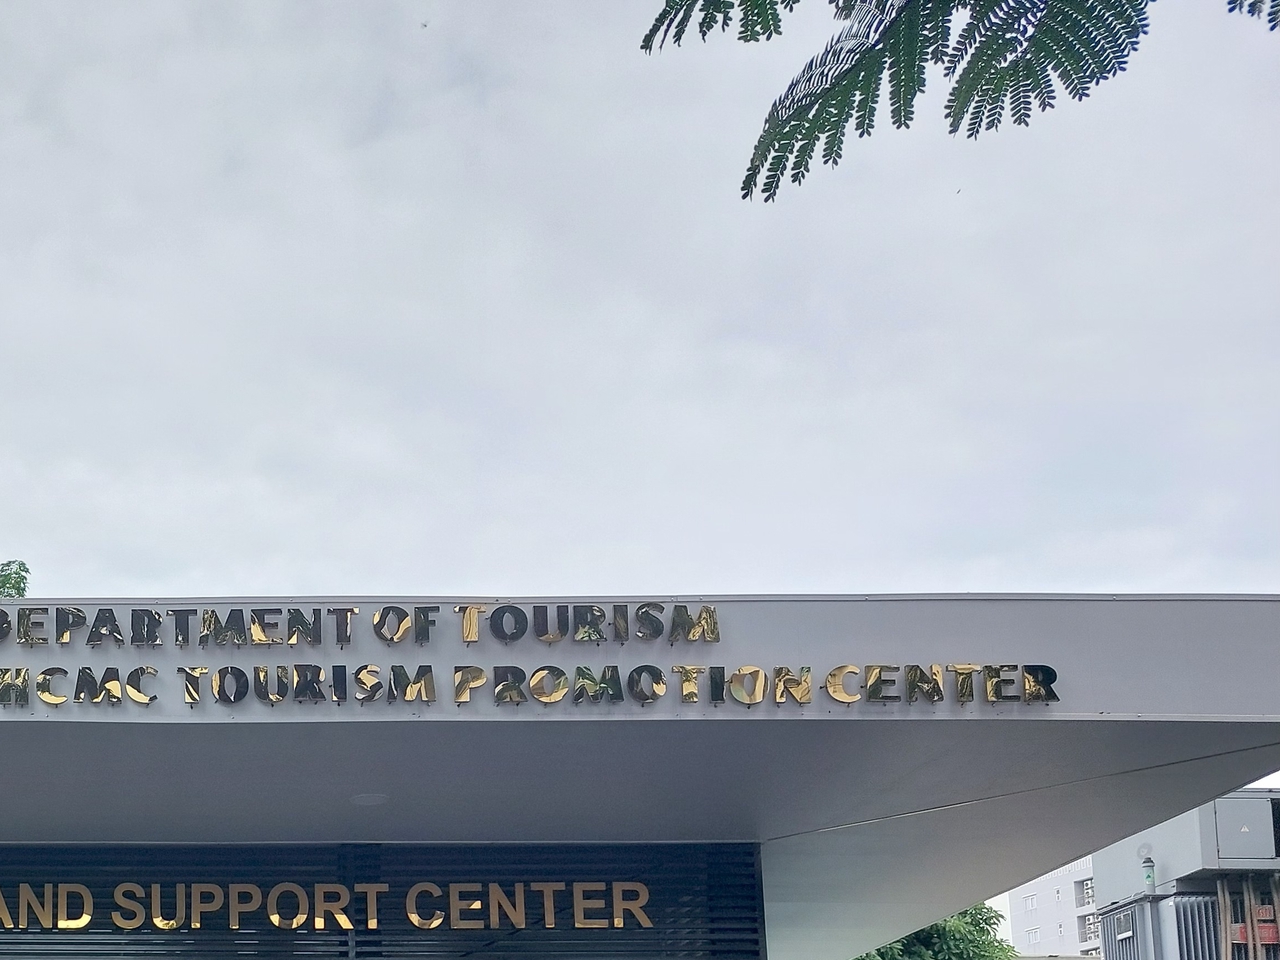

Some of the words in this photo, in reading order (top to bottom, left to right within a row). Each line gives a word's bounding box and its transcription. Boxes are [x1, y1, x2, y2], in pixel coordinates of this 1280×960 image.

[373, 604, 440, 645] OF
[453, 602, 721, 646] TOURISM
[176, 664, 437, 707] TOURISM
[453, 664, 813, 707] PROMOTION
[827, 663, 1062, 704] CENTER
[111, 881, 389, 930] SUPPORT
[405, 881, 654, 929] CENTER
